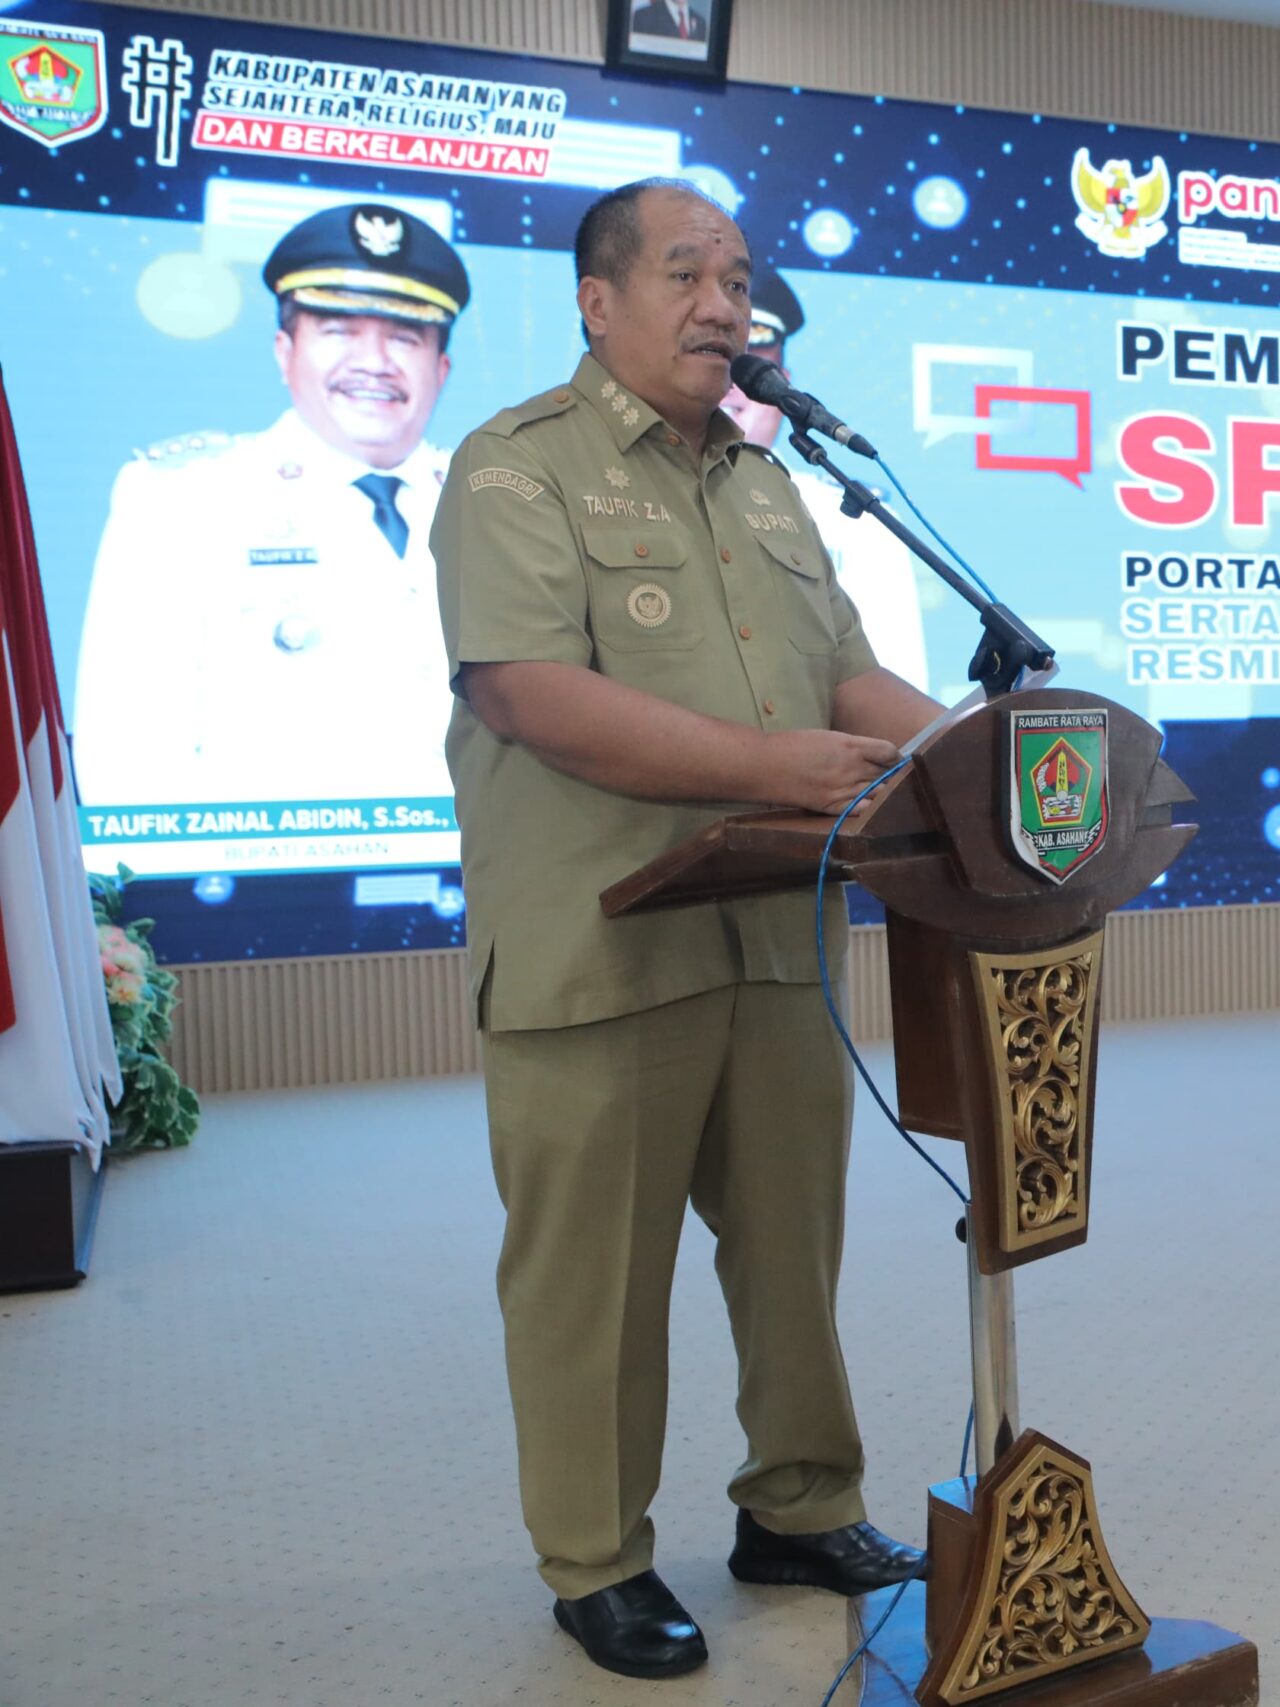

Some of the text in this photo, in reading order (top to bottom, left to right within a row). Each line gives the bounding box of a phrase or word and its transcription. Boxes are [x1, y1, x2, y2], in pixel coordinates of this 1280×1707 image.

[213, 55, 563, 113] KABUPATEN ASAHAN YANG
[207, 86, 556, 139] SEJAHTERA, RELIGIUS, MAJU
[203, 118, 547, 174] DAN BERKELANJUTAN
[583, 495, 639, 519] TAUFIK
[744, 511, 800, 535] BUPATI
[1125, 602, 1280, 635] SERTA
[1132, 648, 1280, 681] RESMI
[1018, 715, 1104, 728] RAMBATE RATA RAYA
[88, 812, 182, 838] TAUFIK
[187, 811, 274, 834] ZAINAL
[279, 808, 369, 832] ABIDIN,
[1038, 833, 1086, 847] KAB. ASAHAN
